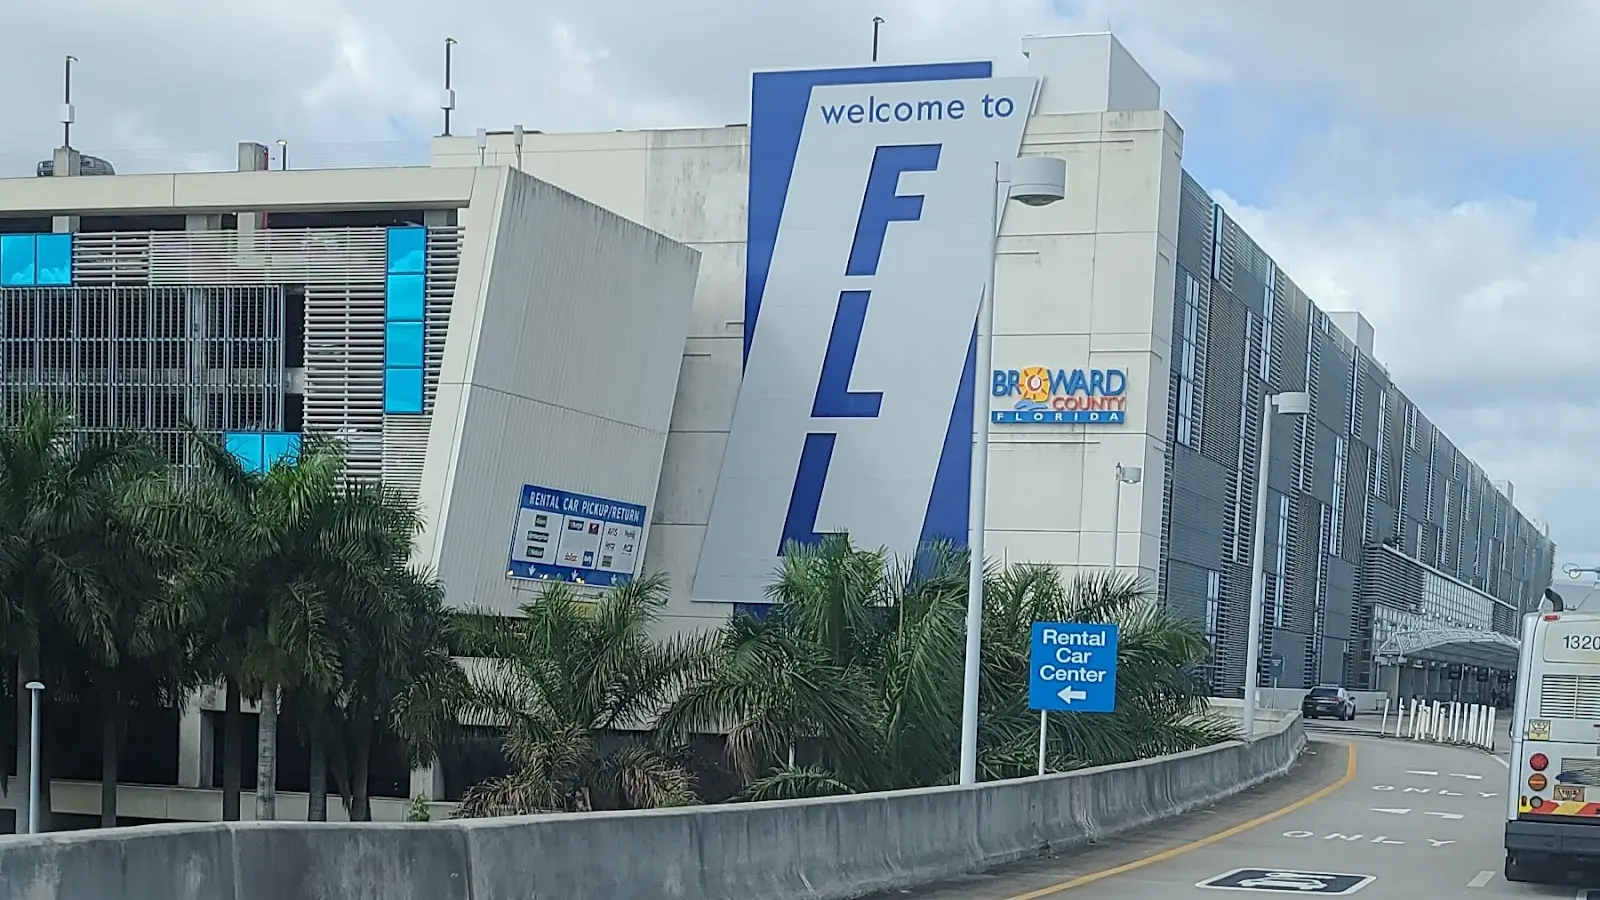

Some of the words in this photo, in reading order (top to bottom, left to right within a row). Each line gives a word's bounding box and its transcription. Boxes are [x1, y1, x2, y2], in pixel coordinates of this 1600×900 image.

[820, 96, 965, 124] welcome
[981, 92, 1015, 119] to
[991, 366, 1127, 399] BROWARD
[1052, 396, 1127, 411] COUNTY
[996, 412, 1120, 422] FLORIDA
[529, 490, 560, 509] RENTAL
[562, 497, 579, 513] CAR
[581, 501, 640, 523] PICKUP/RETURN
[1042, 628, 1106, 646] Rental
[1562, 634, 1600, 651] 1320
[1055, 647, 1092, 664] Car
[1039, 664, 1107, 683] Center
[1371, 785, 1500, 798] ONLY
[1282, 830, 1456, 847] ONLY
